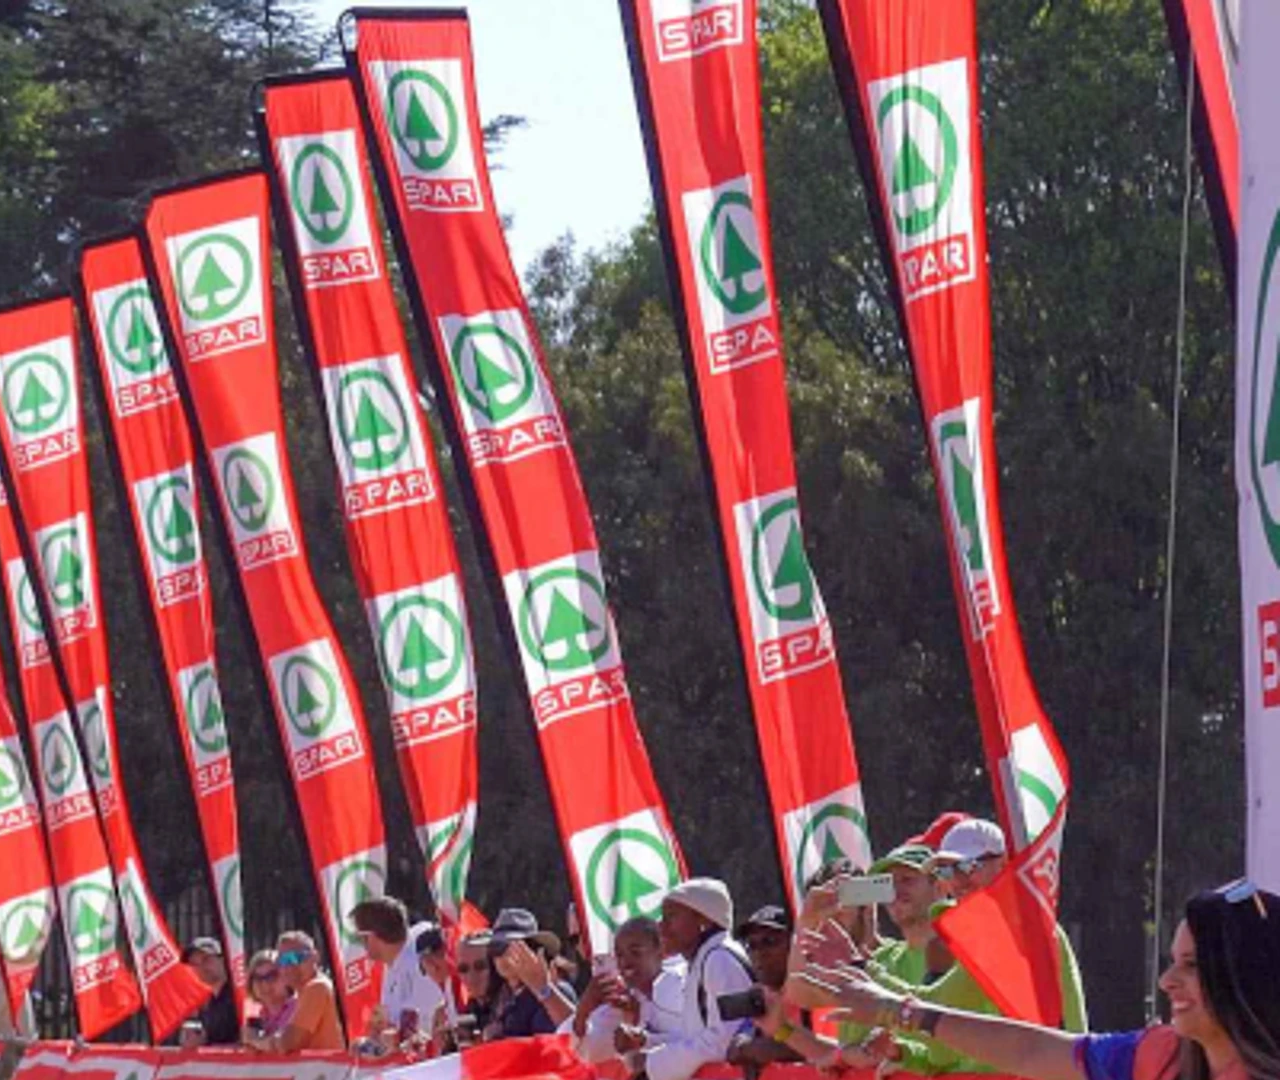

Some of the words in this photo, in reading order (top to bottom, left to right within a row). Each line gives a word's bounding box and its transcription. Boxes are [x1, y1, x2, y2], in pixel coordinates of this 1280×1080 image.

[662, 9, 735, 50] SPAR
[904, 240, 964, 286] PAR
[185, 319, 261, 358] SPAR
[15, 429, 77, 467] SPAR
